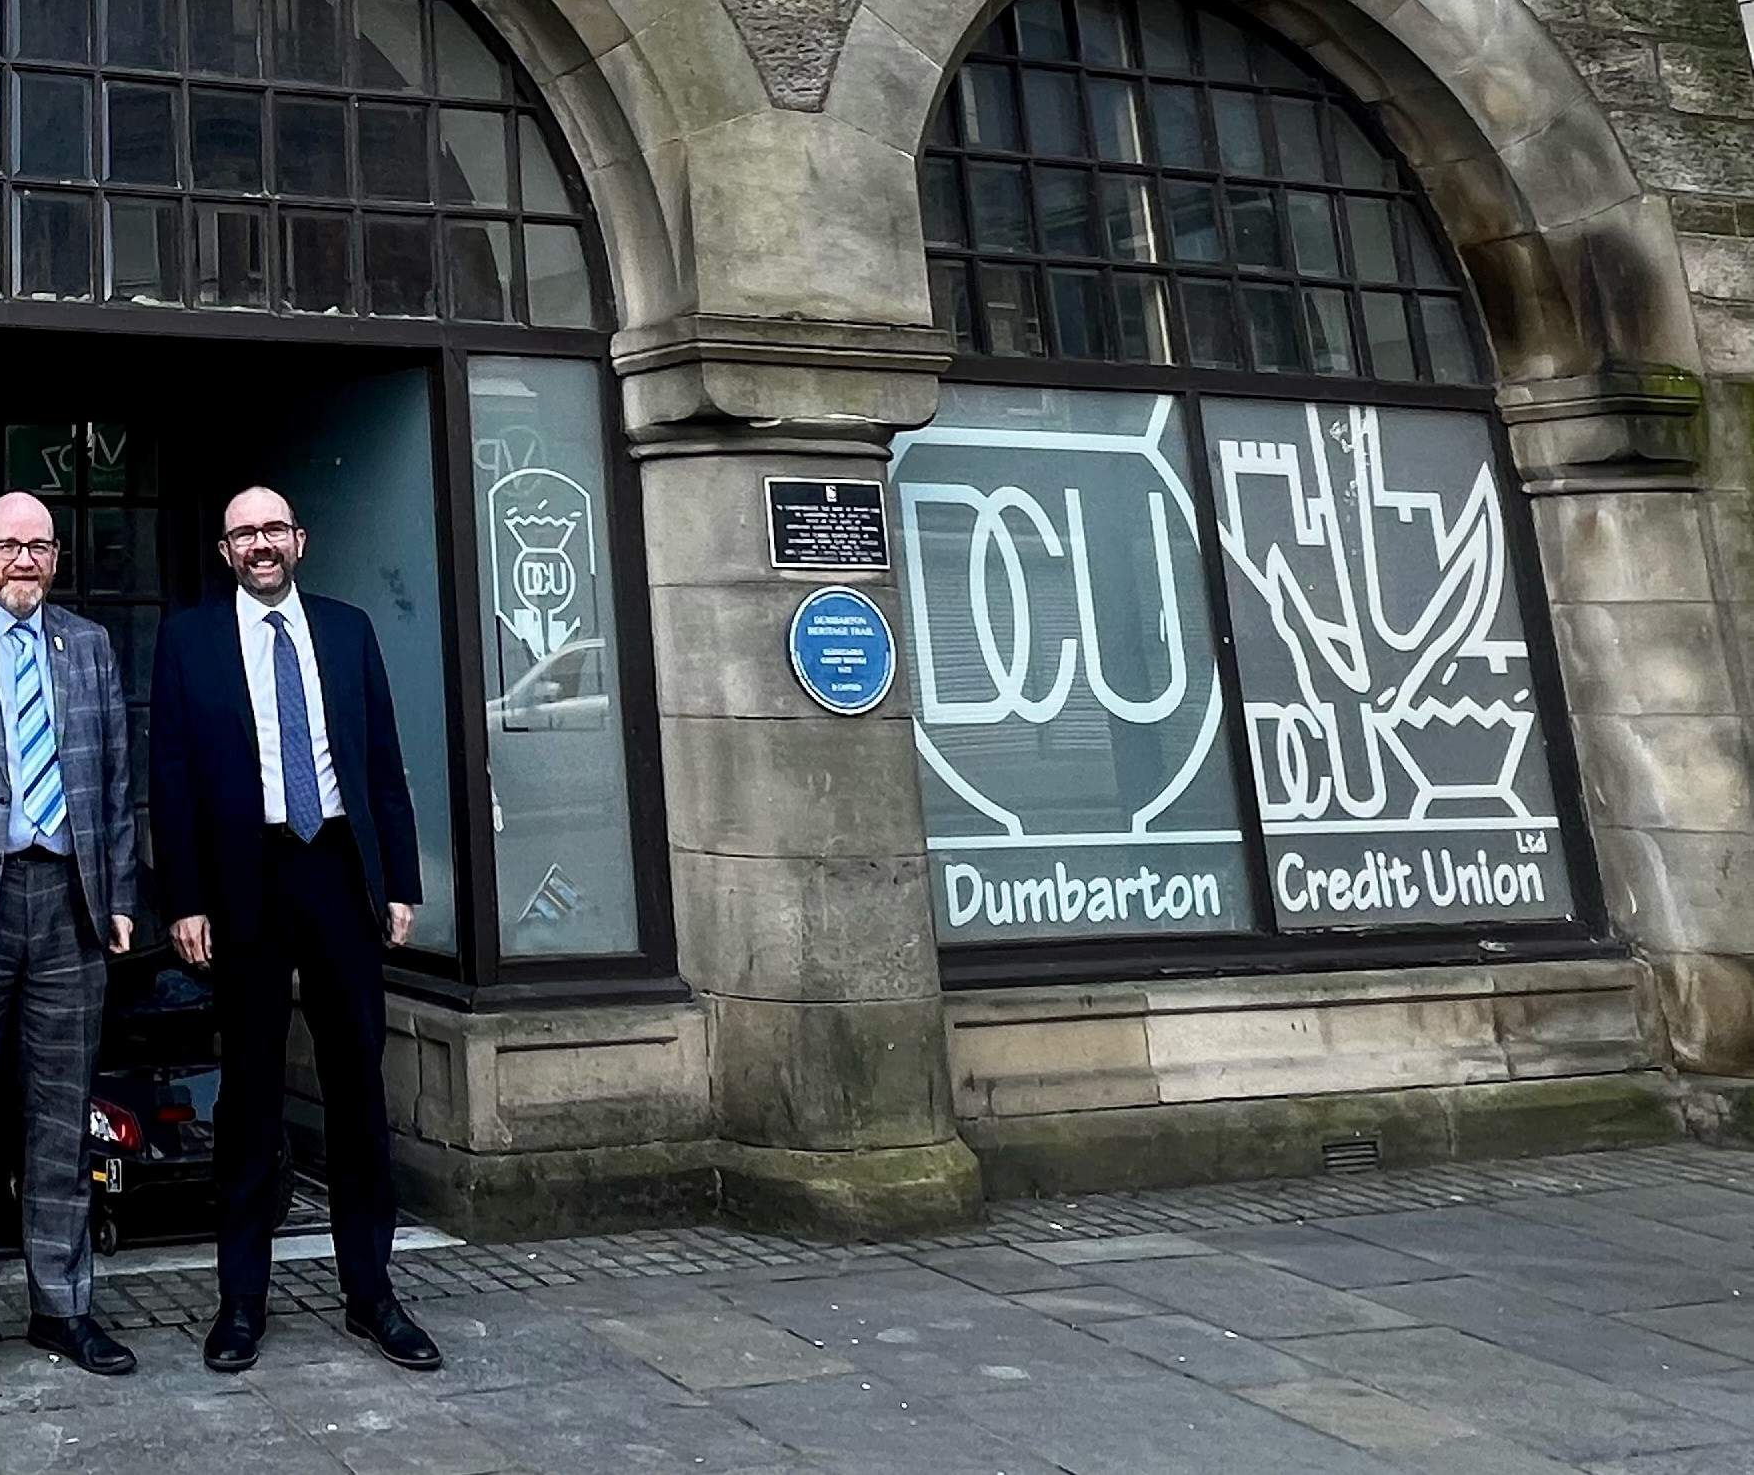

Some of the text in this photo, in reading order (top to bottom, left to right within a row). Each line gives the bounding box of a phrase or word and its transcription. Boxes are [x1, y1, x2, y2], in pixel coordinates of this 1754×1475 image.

[522, 561, 567, 596] DCU
[899, 481, 1187, 725] DCU
[1244, 702, 1388, 820] DCU
[1516, 831, 1548, 854] Ltd
[945, 861, 1221, 927] Dumbarton
[1276, 848, 1545, 913] Credit Union
